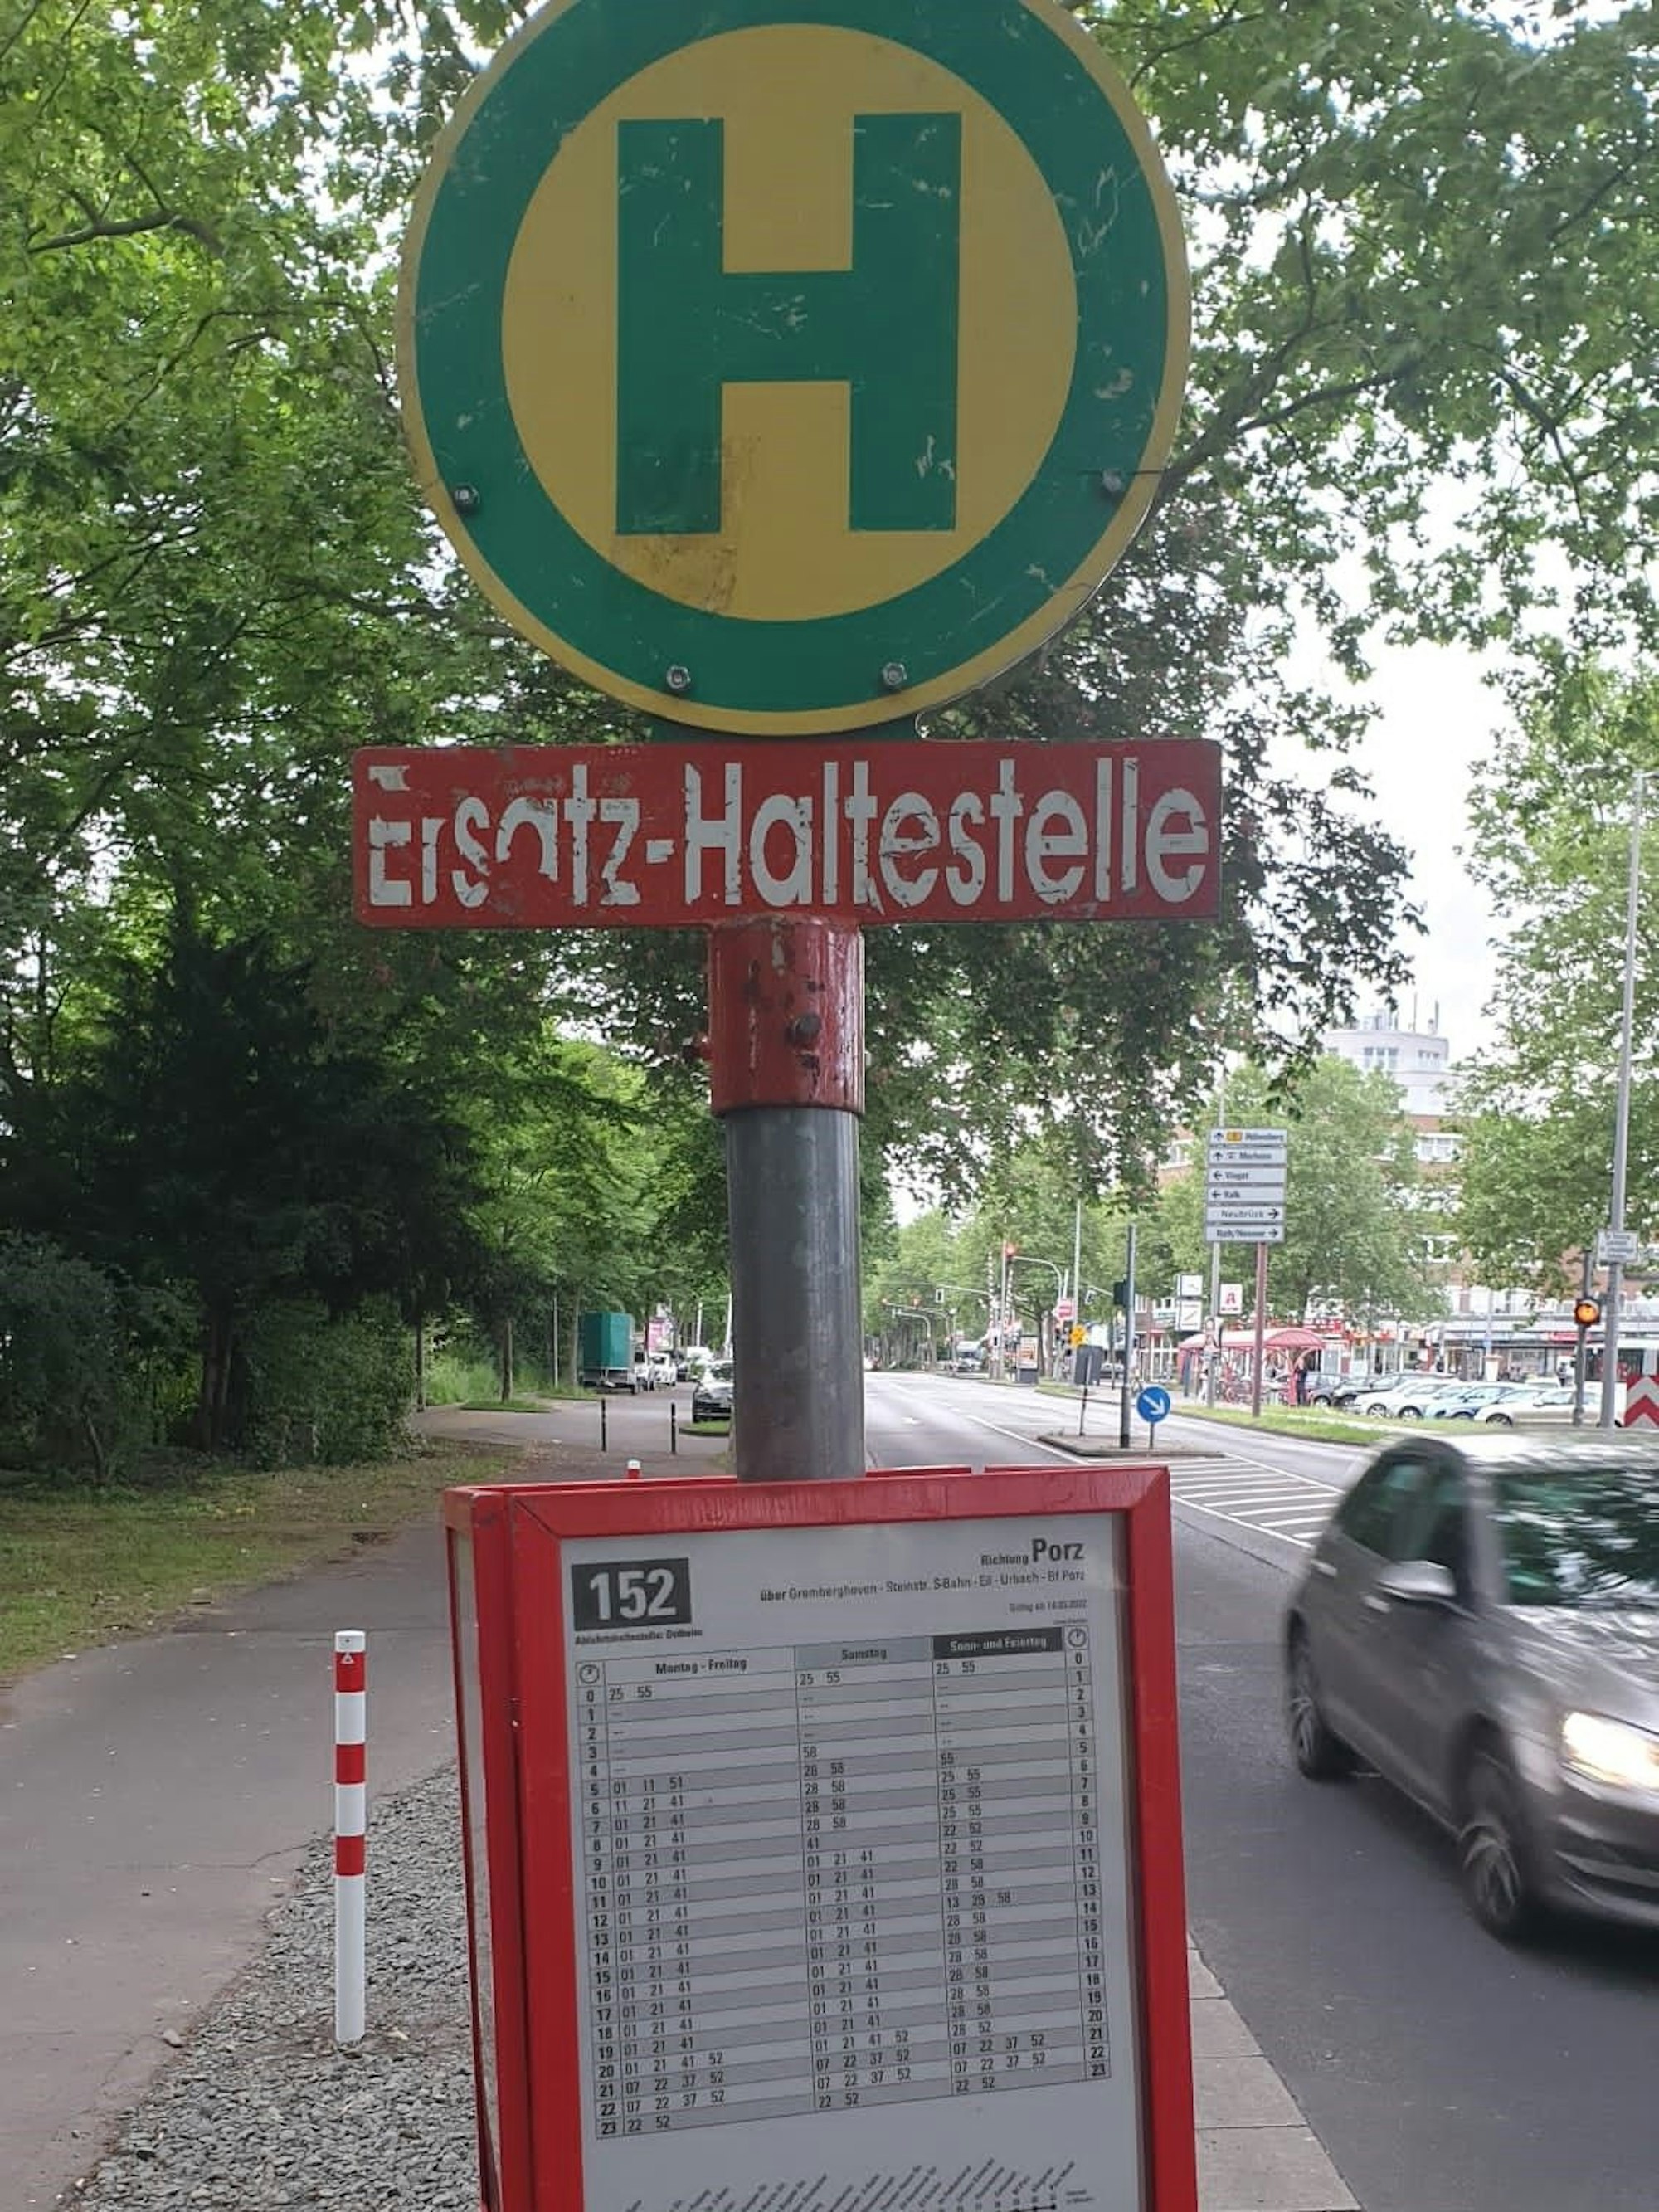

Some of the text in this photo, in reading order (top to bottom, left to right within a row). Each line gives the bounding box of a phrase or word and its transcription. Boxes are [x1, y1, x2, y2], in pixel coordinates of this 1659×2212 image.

[616, 112, 961, 534] H
[367, 757, 1208, 913] Ersatz-Haltestelle
[981, 1537, 1085, 1566] Richtung Porz
[589, 1567, 677, 1620] 152
[761, 1588, 786, 1601] über
[789, 1583, 877, 1600] Gremberghoven
[1000, 1571, 1039, 1586] Urbach
[1063, 1568, 1085, 1581] Porz
[655, 1662, 698, 1674] Montag
[708, 1657, 747, 1670] Freitag
[841, 1648, 888, 1661] Samstag
[586, 1689, 594, 1703] 0
[609, 1688, 623, 1700] 25
[637, 1685, 652, 1698] 55
[799, 1673, 814, 1685] 25
[826, 1670, 840, 1683] 55
[588, 1708, 594, 1721] 1
[587, 1727, 596, 1740] 2
[588, 1746, 597, 1759] 3
[590, 1776, 683, 1796] 5 01 11 51
[615, 1800, 626, 1812] 11
[642, 1797, 655, 1810] 21
[670, 1795, 683, 1806] 41
[592, 1820, 601, 1834] 7
[615, 1818, 628, 1830] 01
[643, 1815, 656, 1829] 21
[670, 1813, 684, 1825] 41
[615, 1836, 628, 1849] 01
[644, 1834, 656, 1847] 21
[671, 1831, 684, 1843] 41
[591, 1876, 606, 1889] 10
[616, 1873, 630, 1887] 01
[645, 1871, 658, 1884] 21
[673, 1869, 685, 1880] 41
[807, 1855, 820, 1867] 01
[834, 1853, 846, 1865] 21
[860, 1849, 872, 1862] 41
[592, 1895, 606, 1908] 11
[593, 1914, 607, 1927] 12
[618, 1912, 631, 1924] 01
[647, 1908, 659, 1922] 21
[674, 1906, 687, 1918] 41
[808, 1891, 820, 1904] 01
[835, 1889, 847, 1902] 21
[862, 1886, 873, 1898] 41
[594, 1932, 609, 1946] 13
[595, 1951, 609, 1966] 14
[620, 1949, 633, 1962] 01
[648, 1946, 661, 1959] 21
[676, 1942, 688, 1956] 41
[810, 1928, 822, 1942] 01
[837, 1925, 849, 1938] 21
[863, 1922, 875, 1934] 41
[596, 1970, 610, 1984] 15
[596, 1989, 611, 2003] 16
[621, 1986, 635, 2000] 01
[649, 1983, 663, 1996] 21
[678, 1980, 690, 1992] 41
[811, 1965, 824, 1978] 01
[839, 1962, 850, 1975] 21
[865, 1959, 877, 1971] 41
[596, 2007, 611, 2021] 17
[598, 2026, 612, 2039] 18
[623, 2024, 636, 2038] 01
[652, 2021, 664, 2034] 21
[679, 2017, 692, 2030] 41
[813, 2001, 825, 2015] 01
[840, 1999, 852, 2012] 21
[867, 1996, 878, 2008] 41
[598, 2045, 613, 2059] 19
[599, 2064, 614, 2078] 20
[625, 2062, 638, 2075] 01
[654, 2059, 665, 2072] 21
[681, 2055, 693, 2068] 41
[708, 2051, 722, 2065] 52
[815, 2039, 827, 2052] 01
[842, 2035, 854, 2049] 21
[868, 2033, 881, 2045] 41
[895, 2029, 908, 2043] 52
[599, 2083, 613, 2098] 21
[625, 2080, 640, 2094] 07
[654, 2078, 668, 2091] 22
[681, 2073, 695, 2088] 37
[709, 2070, 724, 2084] 52
[816, 2058, 830, 2071] 07
[843, 2054, 856, 2068] 22
[869, 2051, 883, 2065] 37
[896, 2048, 909, 2062] 52
[601, 2102, 615, 2116] 22
[626, 2099, 640, 2112] 07
[655, 2096, 669, 2110] 22
[683, 2093, 697, 2107] 37
[711, 2089, 724, 2103] 52
[817, 2076, 830, 2090] 07
[844, 2073, 857, 2087] 22
[871, 2070, 884, 2083] 37
[898, 2067, 910, 2080] 52
[601, 2121, 616, 2135] 23
[627, 2118, 641, 2132] 22
[655, 2114, 669, 2128] 52
[818, 2094, 831, 2108] 22
[845, 2091, 859, 2106] 52
